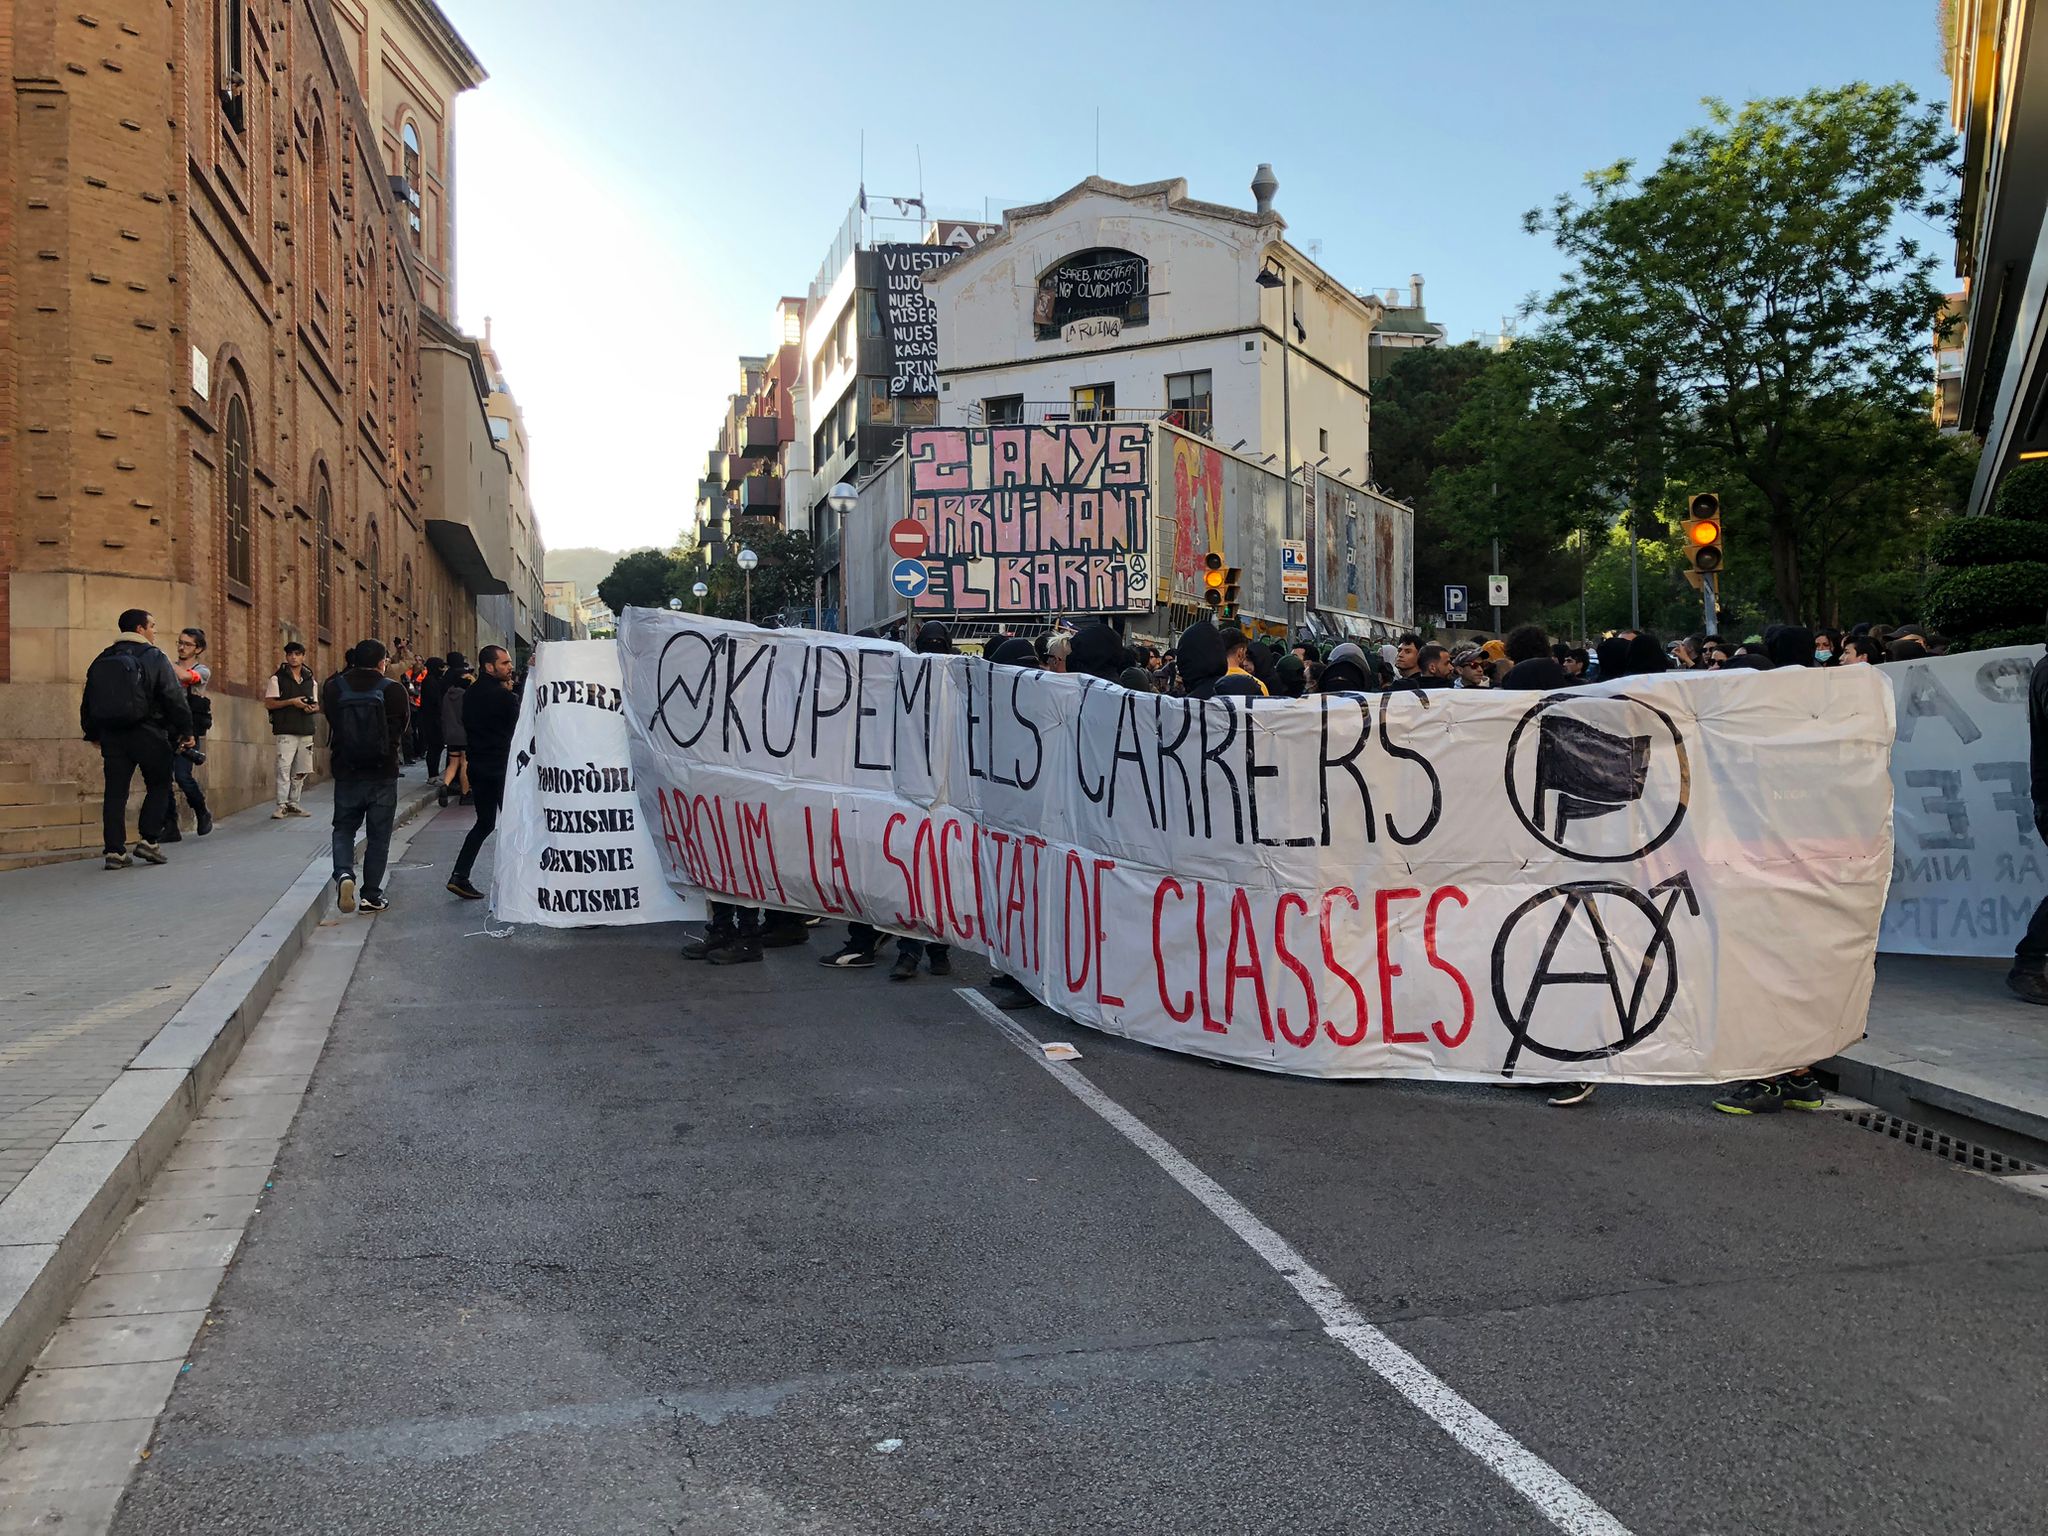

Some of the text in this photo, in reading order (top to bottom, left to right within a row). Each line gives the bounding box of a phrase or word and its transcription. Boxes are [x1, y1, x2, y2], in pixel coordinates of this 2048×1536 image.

[895, 341, 938, 358] KASAS
[991, 424, 1149, 489] ANYS
[1285, 550, 1292, 562] P
[1450, 589, 1463, 610] P
[965, 655, 1044, 791] ELS
[1076, 676, 1443, 847] CARRERS
[539, 846, 635, 874] SEXISME
[537, 886, 640, 914] RACISME
[804, 805, 863, 917] LA
[1065, 848, 1126, 1008] DE
[1152, 876, 1476, 1048] CLASSES
